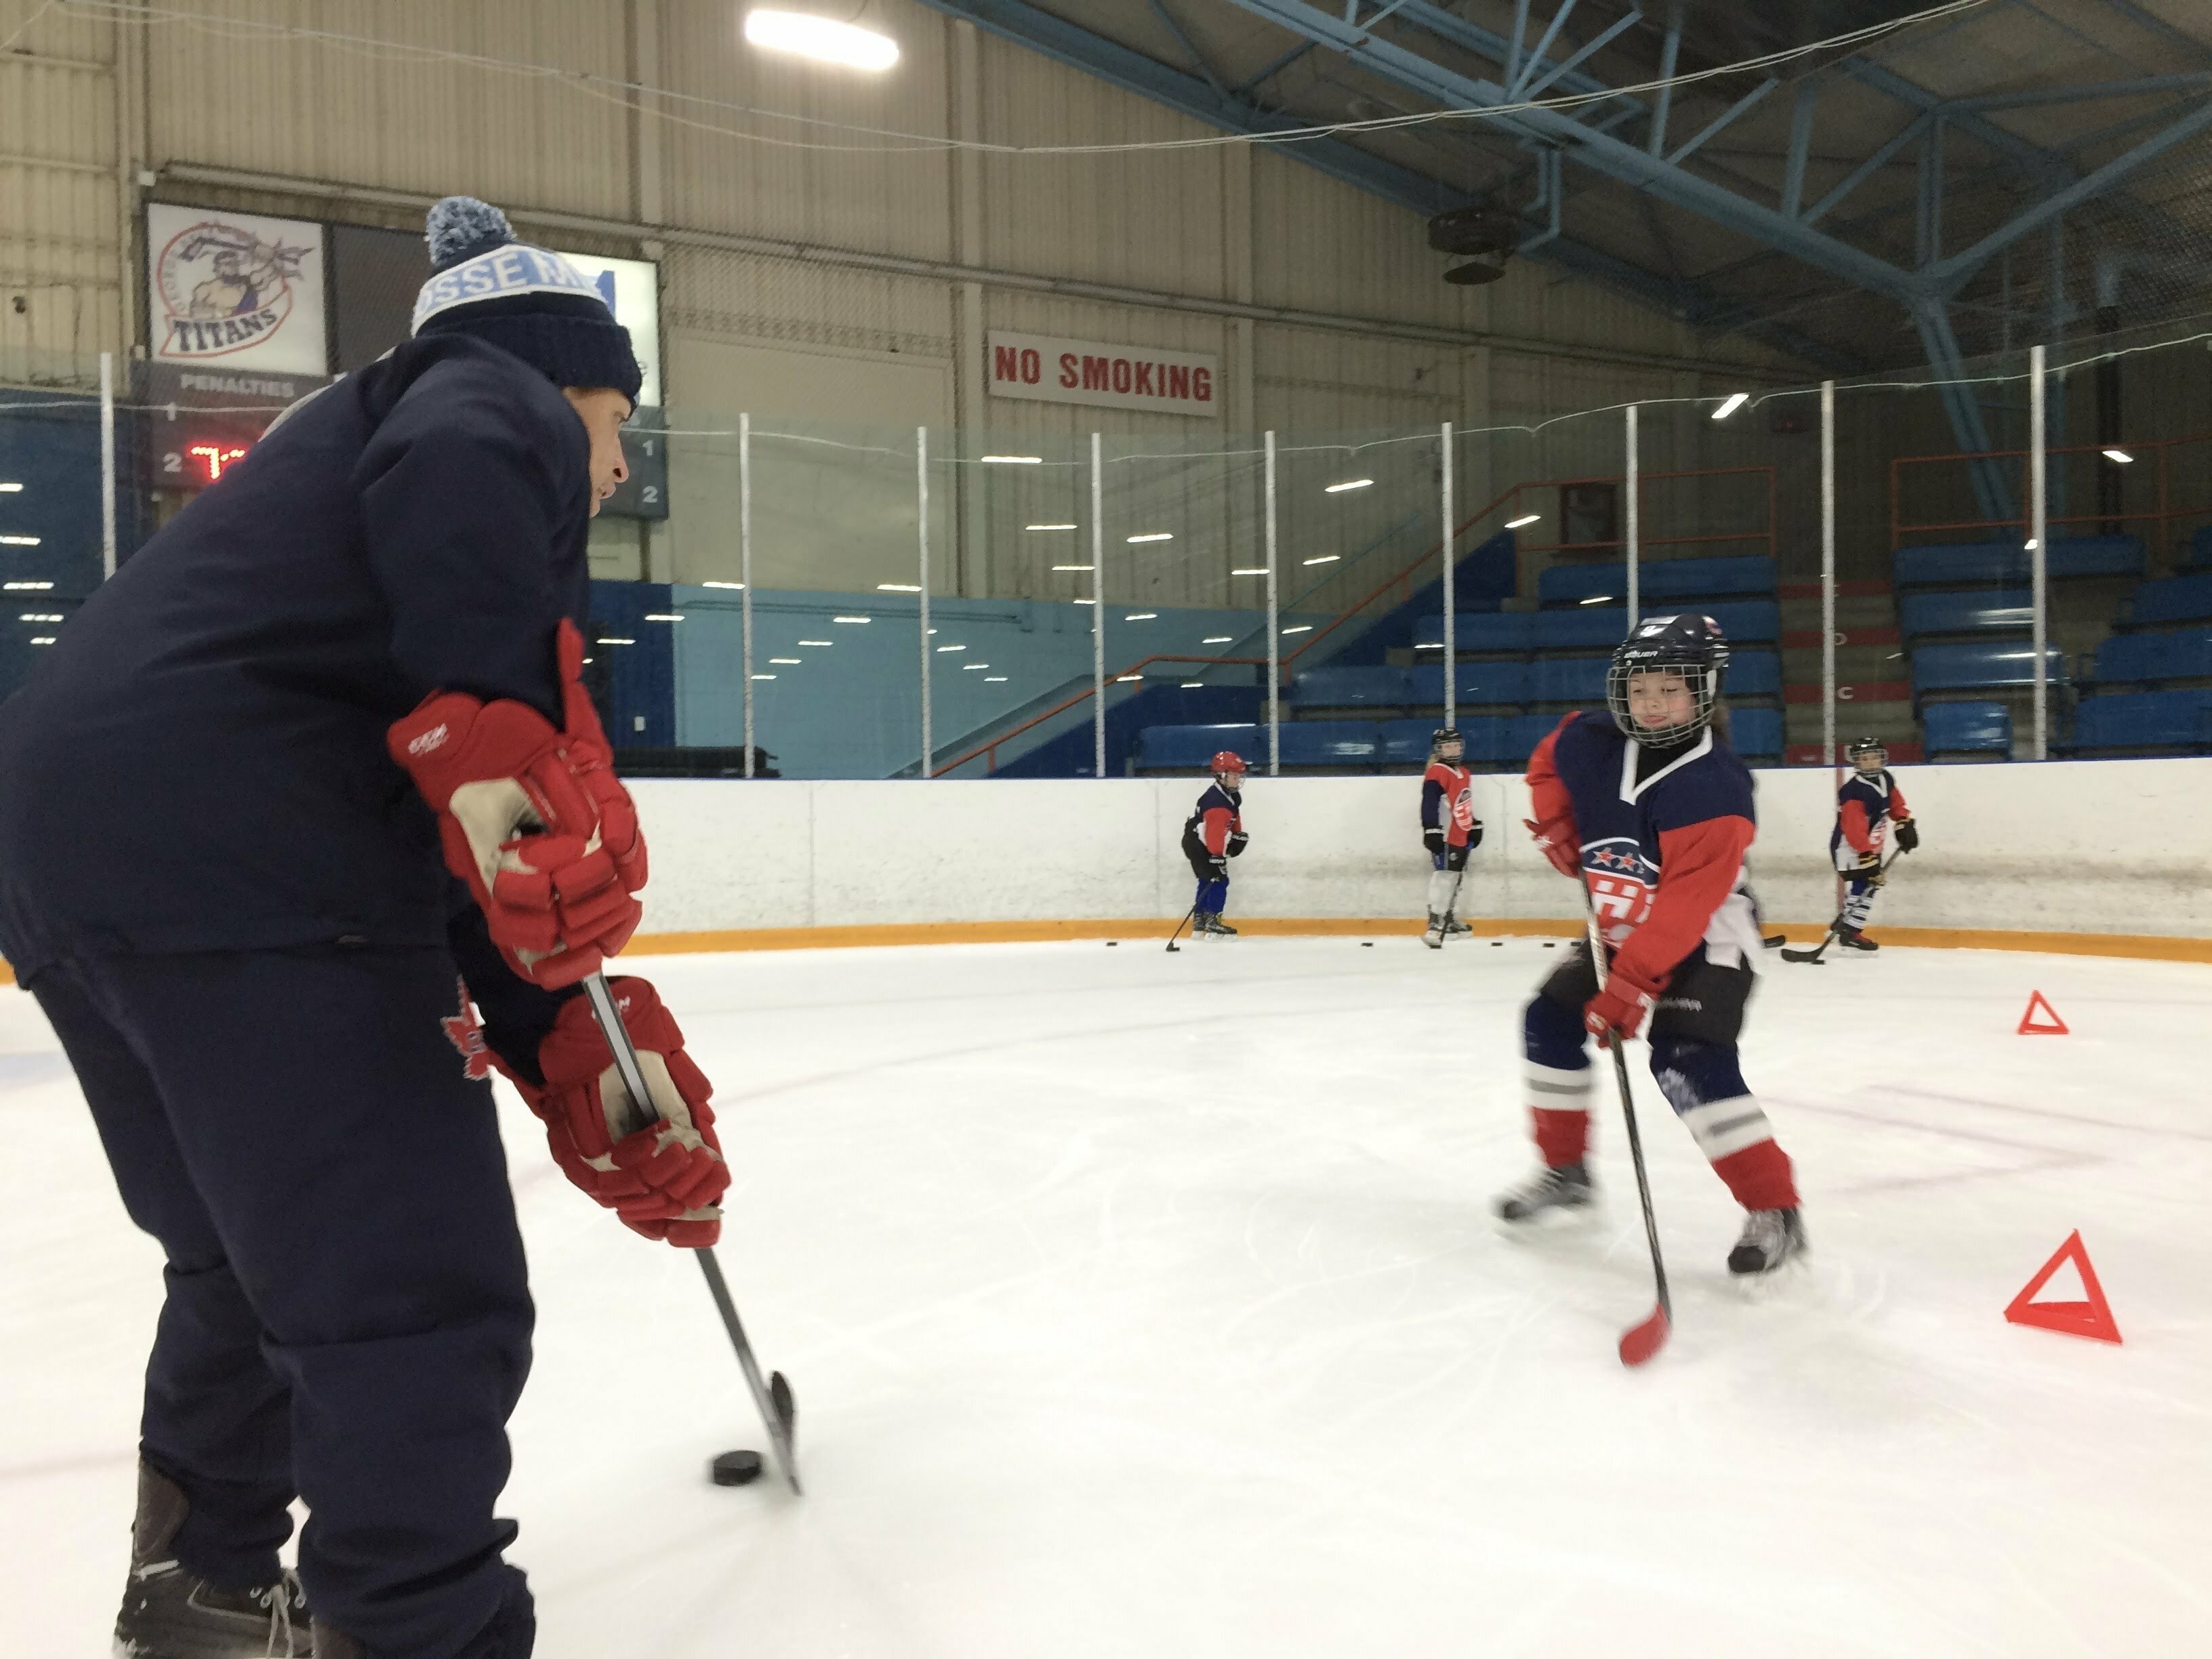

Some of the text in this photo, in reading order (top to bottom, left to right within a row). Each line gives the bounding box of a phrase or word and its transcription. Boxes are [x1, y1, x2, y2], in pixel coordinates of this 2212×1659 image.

[173, 308, 278, 352] TITANS
[994, 346, 1212, 401] NO SMOKING
[180, 373, 294, 398] PENALTIES
[642, 441, 654, 456] 1
[163, 452, 182, 473] 2
[642, 485, 658, 503] 2
[1837, 687, 1854, 699] C
